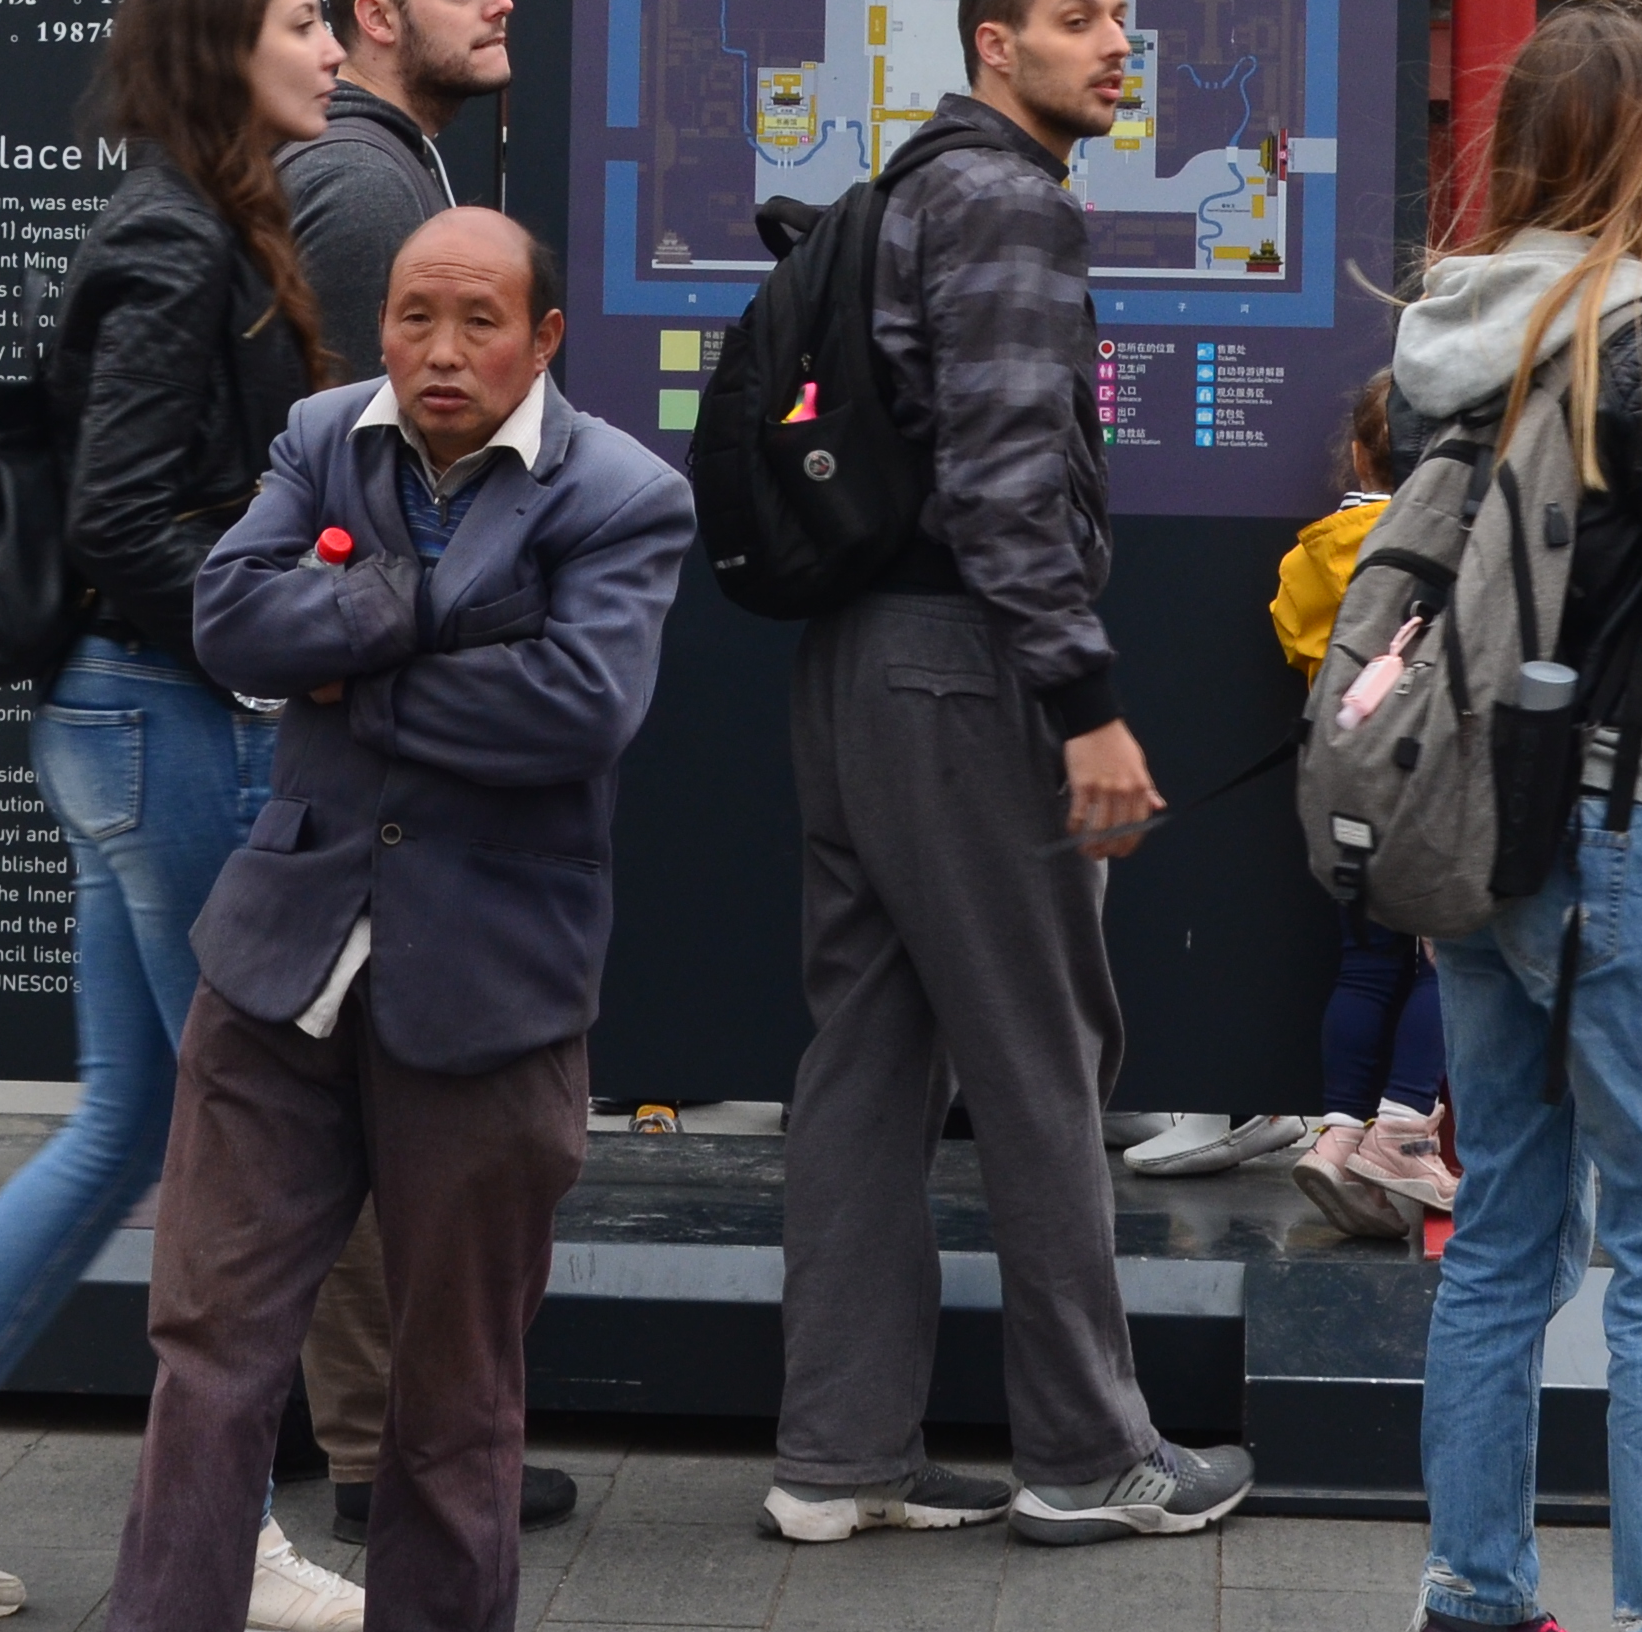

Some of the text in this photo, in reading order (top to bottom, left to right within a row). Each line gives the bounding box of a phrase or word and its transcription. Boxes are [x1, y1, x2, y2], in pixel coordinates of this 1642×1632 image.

[29, 197, 67, 211] was
[24, 251, 68, 274] Ming
[28, 885, 77, 904] Inner
